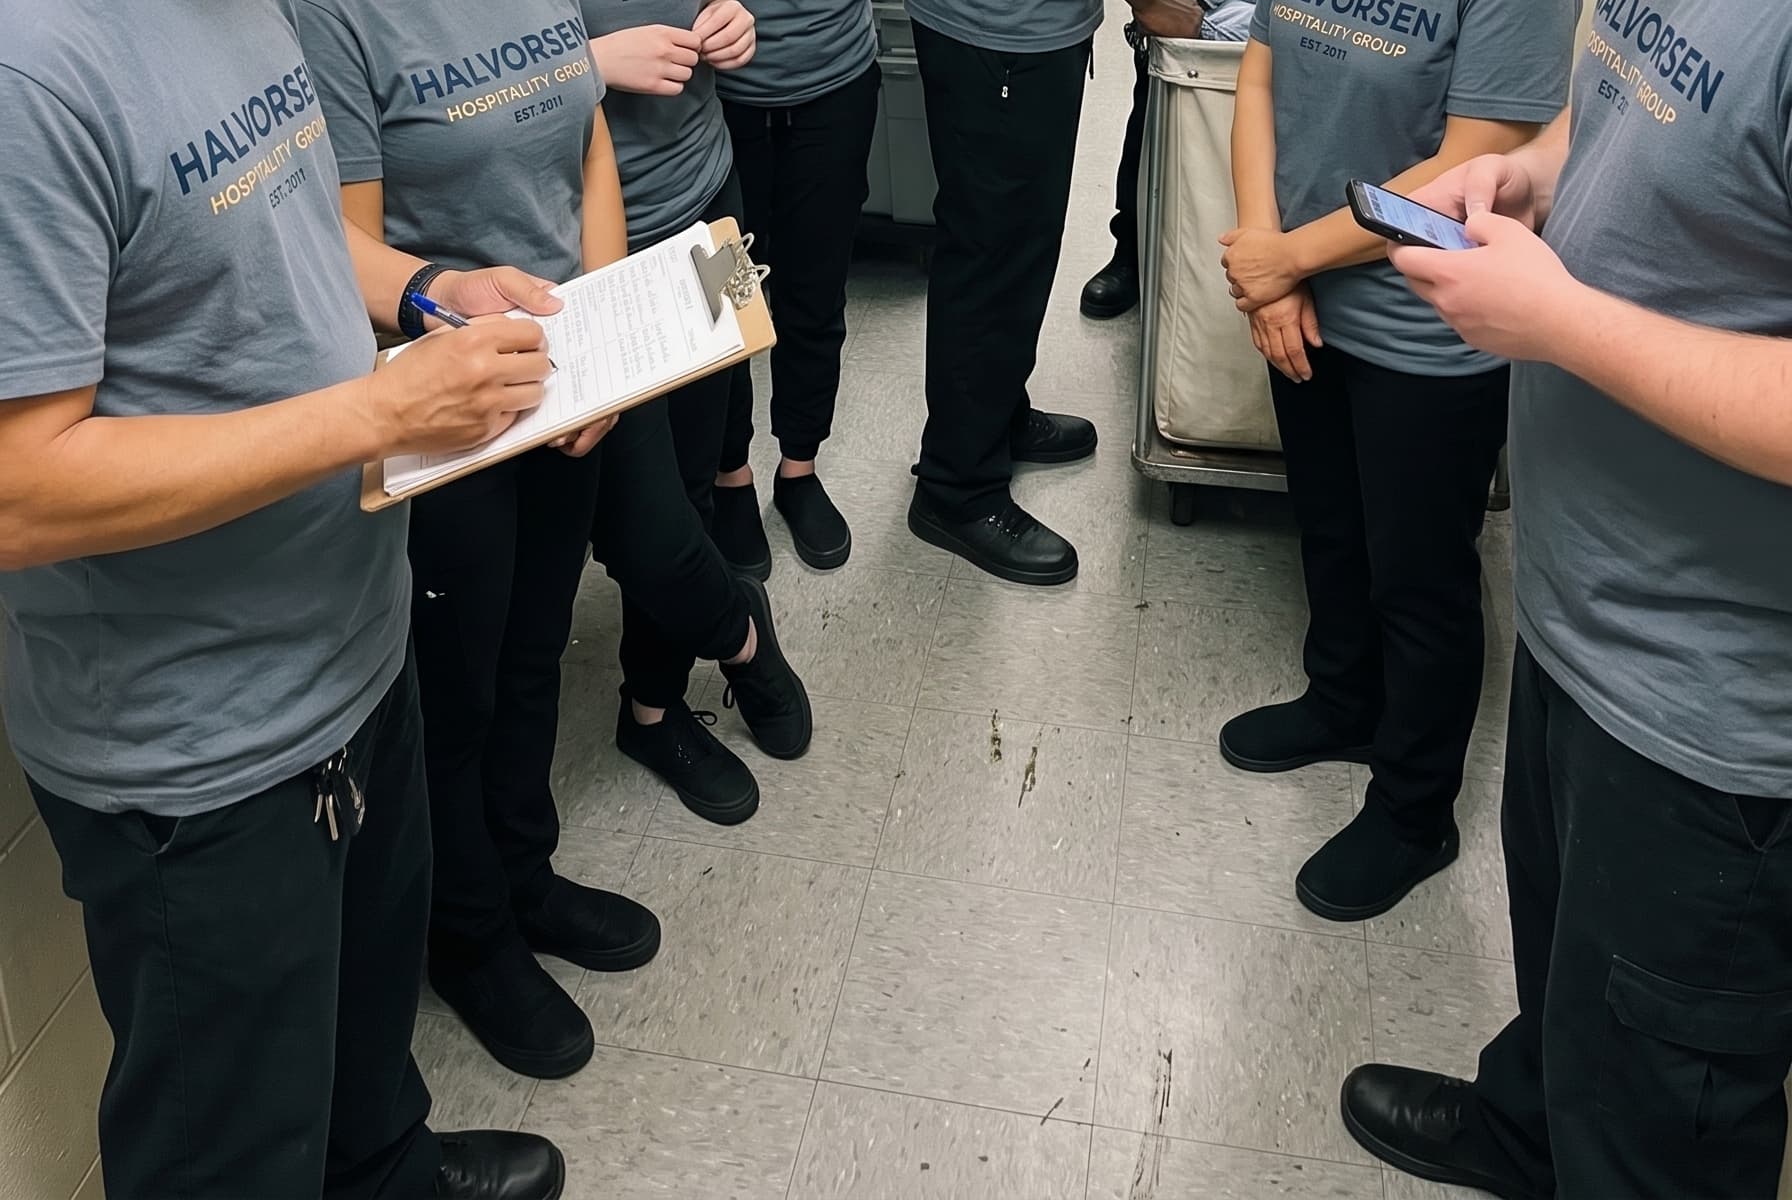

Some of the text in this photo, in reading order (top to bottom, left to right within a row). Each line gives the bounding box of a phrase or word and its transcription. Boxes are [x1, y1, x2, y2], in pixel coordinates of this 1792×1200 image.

[1299, 36, 1348, 61] EST 2011
[1352, 31, 1407, 58] GROUP
[410, 16, 586, 104] HALVORSEN
[447, 73, 550, 122] HOSPITALITY
[1598, 79, 1620, 104] EST
[514, 95, 563, 123] EST. 2011
